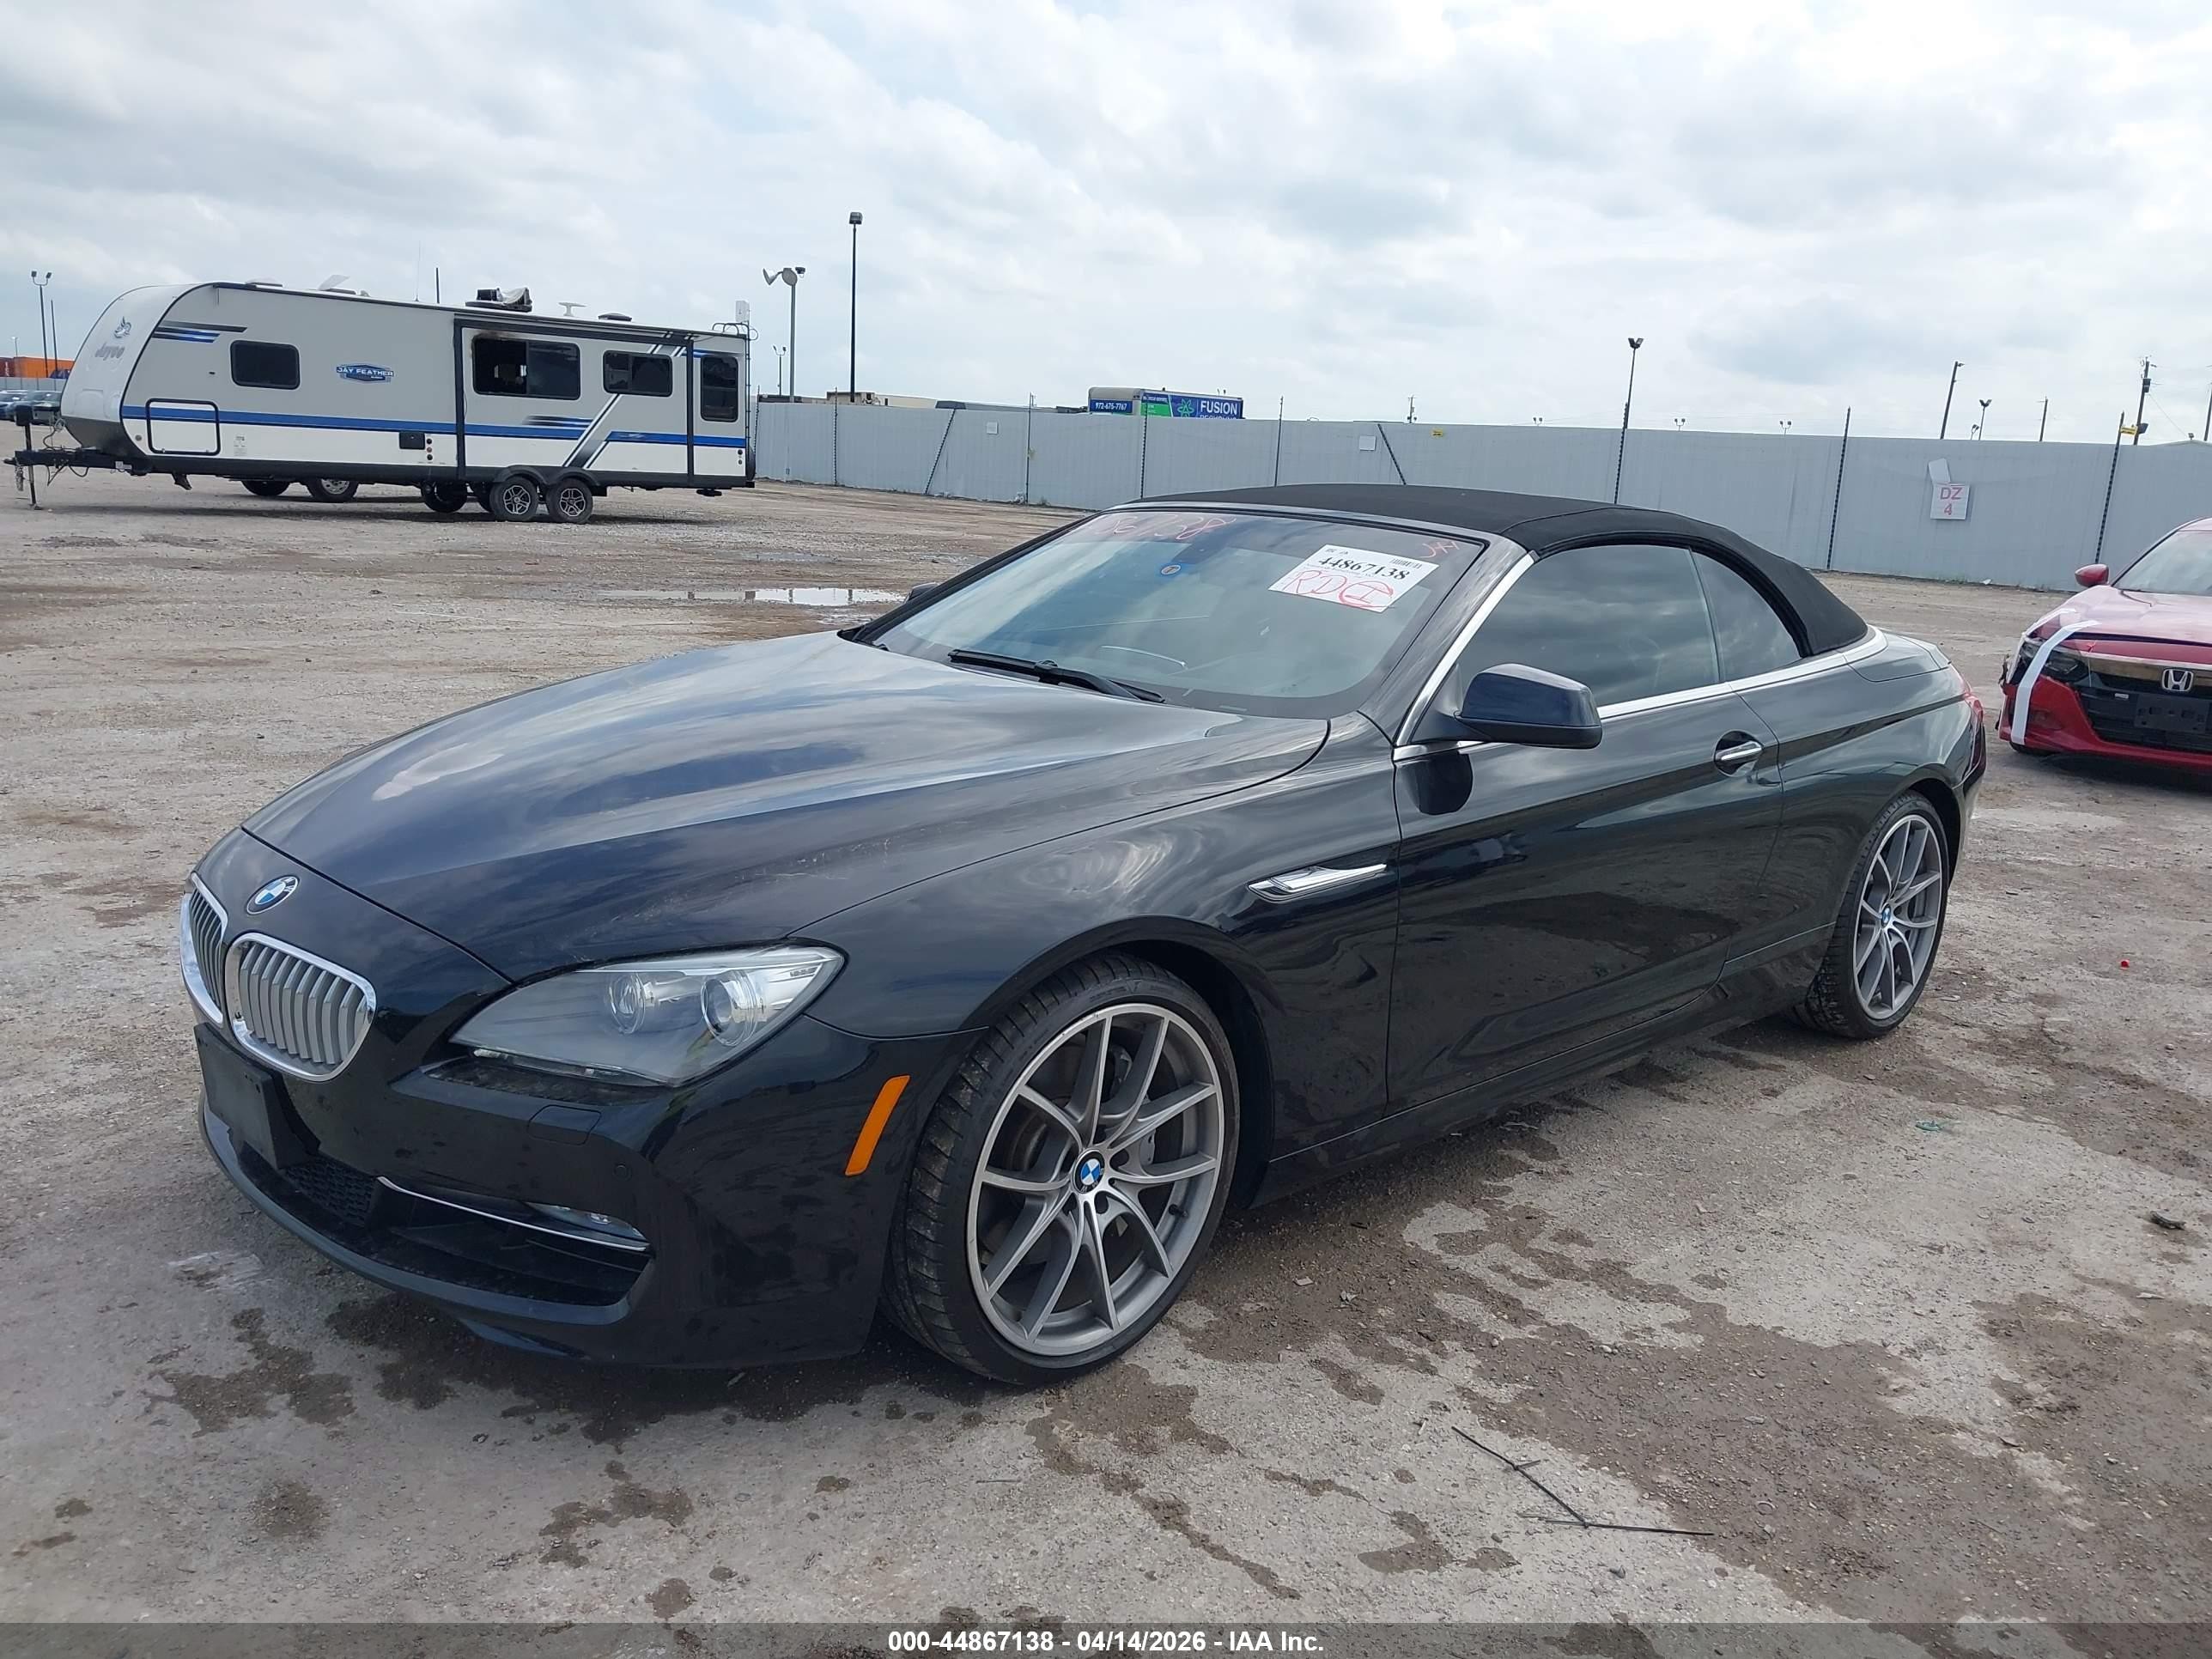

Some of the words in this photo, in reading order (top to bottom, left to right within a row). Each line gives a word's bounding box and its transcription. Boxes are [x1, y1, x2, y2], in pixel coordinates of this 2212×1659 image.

[356, 368, 393, 377] FEATHER
[1200, 400, 1237, 415] FUSION
[1940, 487, 1963, 500] DZ
[1943, 502, 1953, 516] 4
[1318, 556, 1411, 580] 44867138
